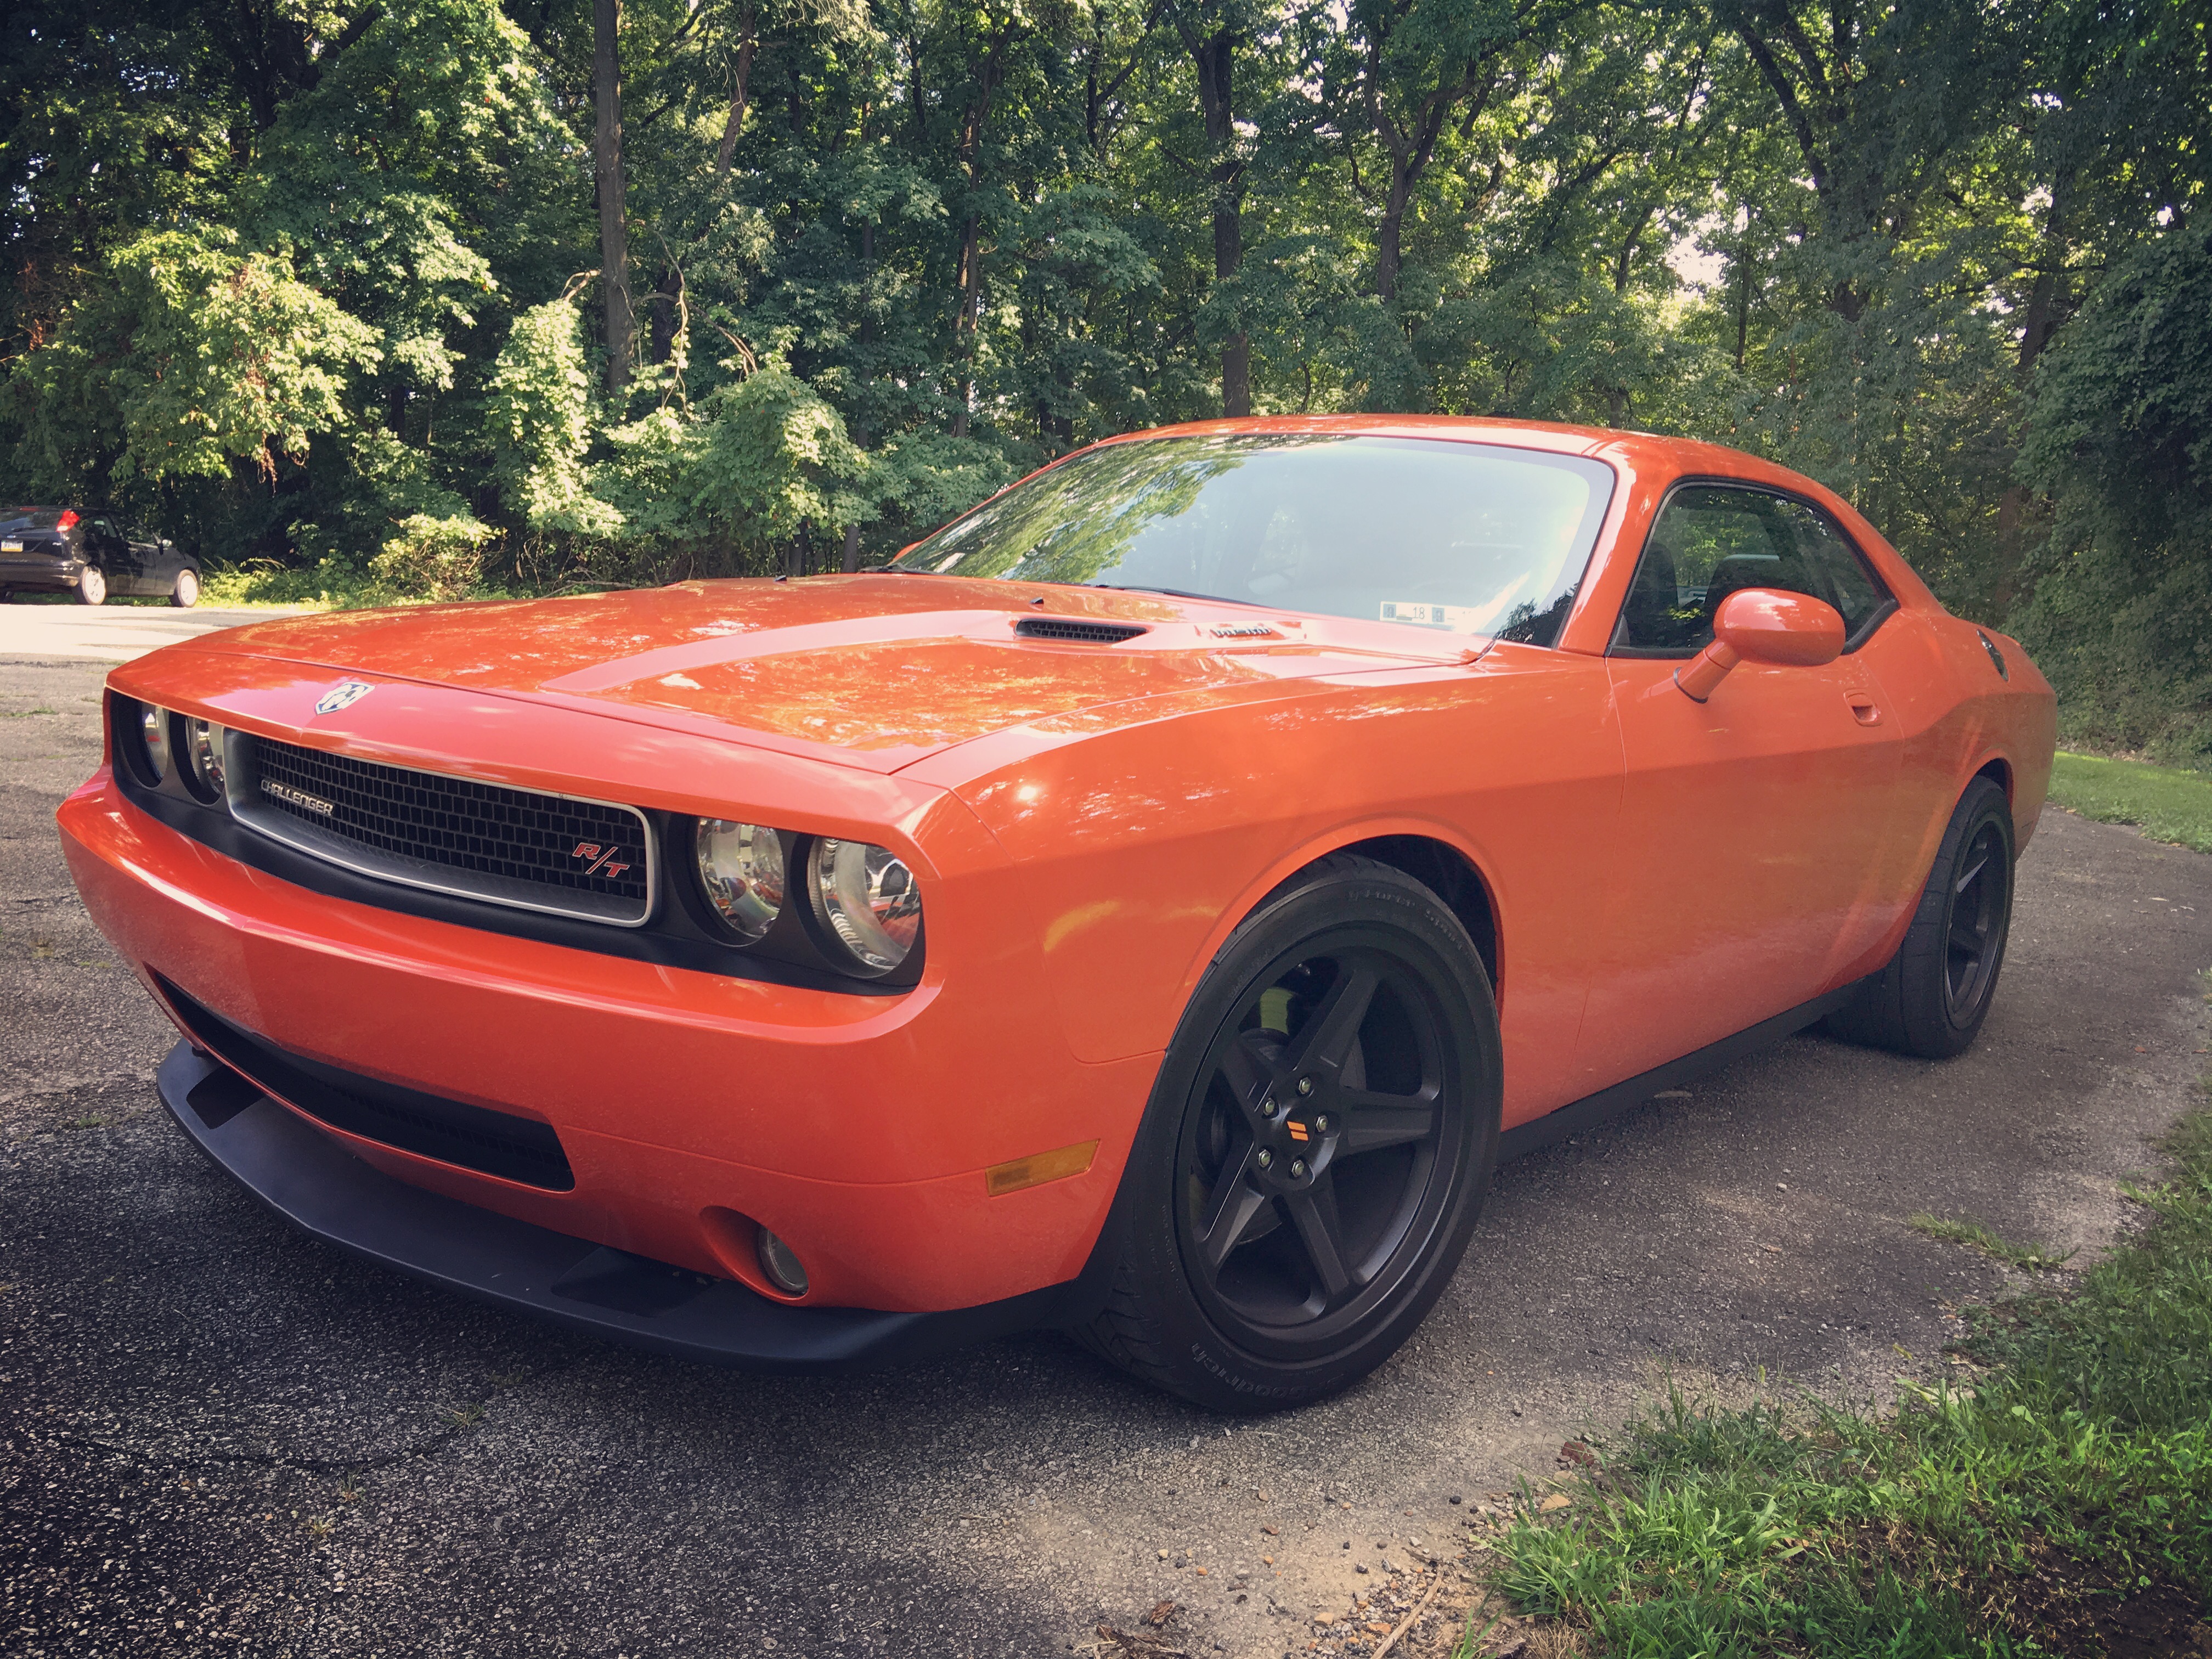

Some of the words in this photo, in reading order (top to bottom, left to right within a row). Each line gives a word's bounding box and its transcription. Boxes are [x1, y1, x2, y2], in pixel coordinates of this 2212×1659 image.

[1413, 607, 1425, 619] 18
[261, 780, 333, 816] CHALLENGER
[572, 842, 630, 877] R/T
